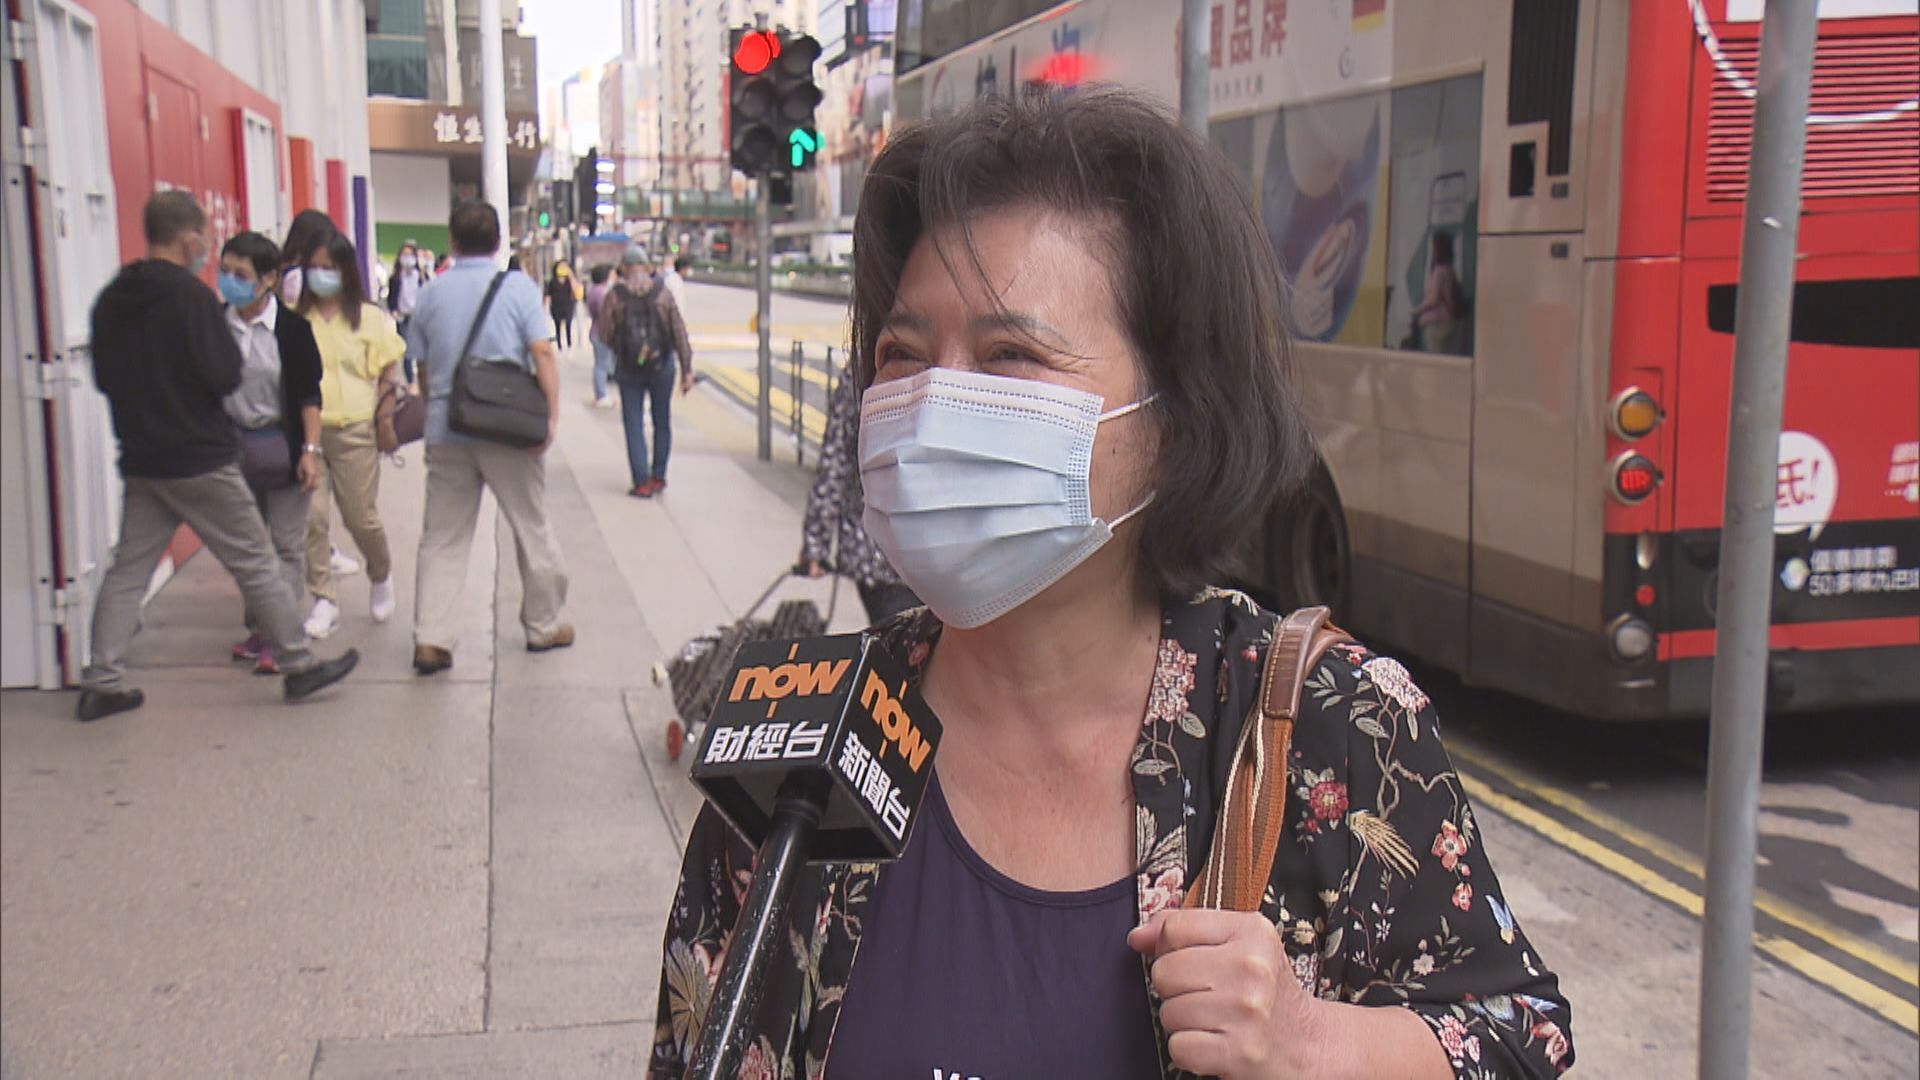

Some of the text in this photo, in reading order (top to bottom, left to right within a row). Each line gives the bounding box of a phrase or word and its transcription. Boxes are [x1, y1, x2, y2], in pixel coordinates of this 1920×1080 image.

[433, 111, 536, 149] 恒生行
[728, 658, 852, 703] now
[703, 721, 829, 764] 財經台
[861, 668, 931, 773] now
[838, 730, 910, 841] 新聞台
